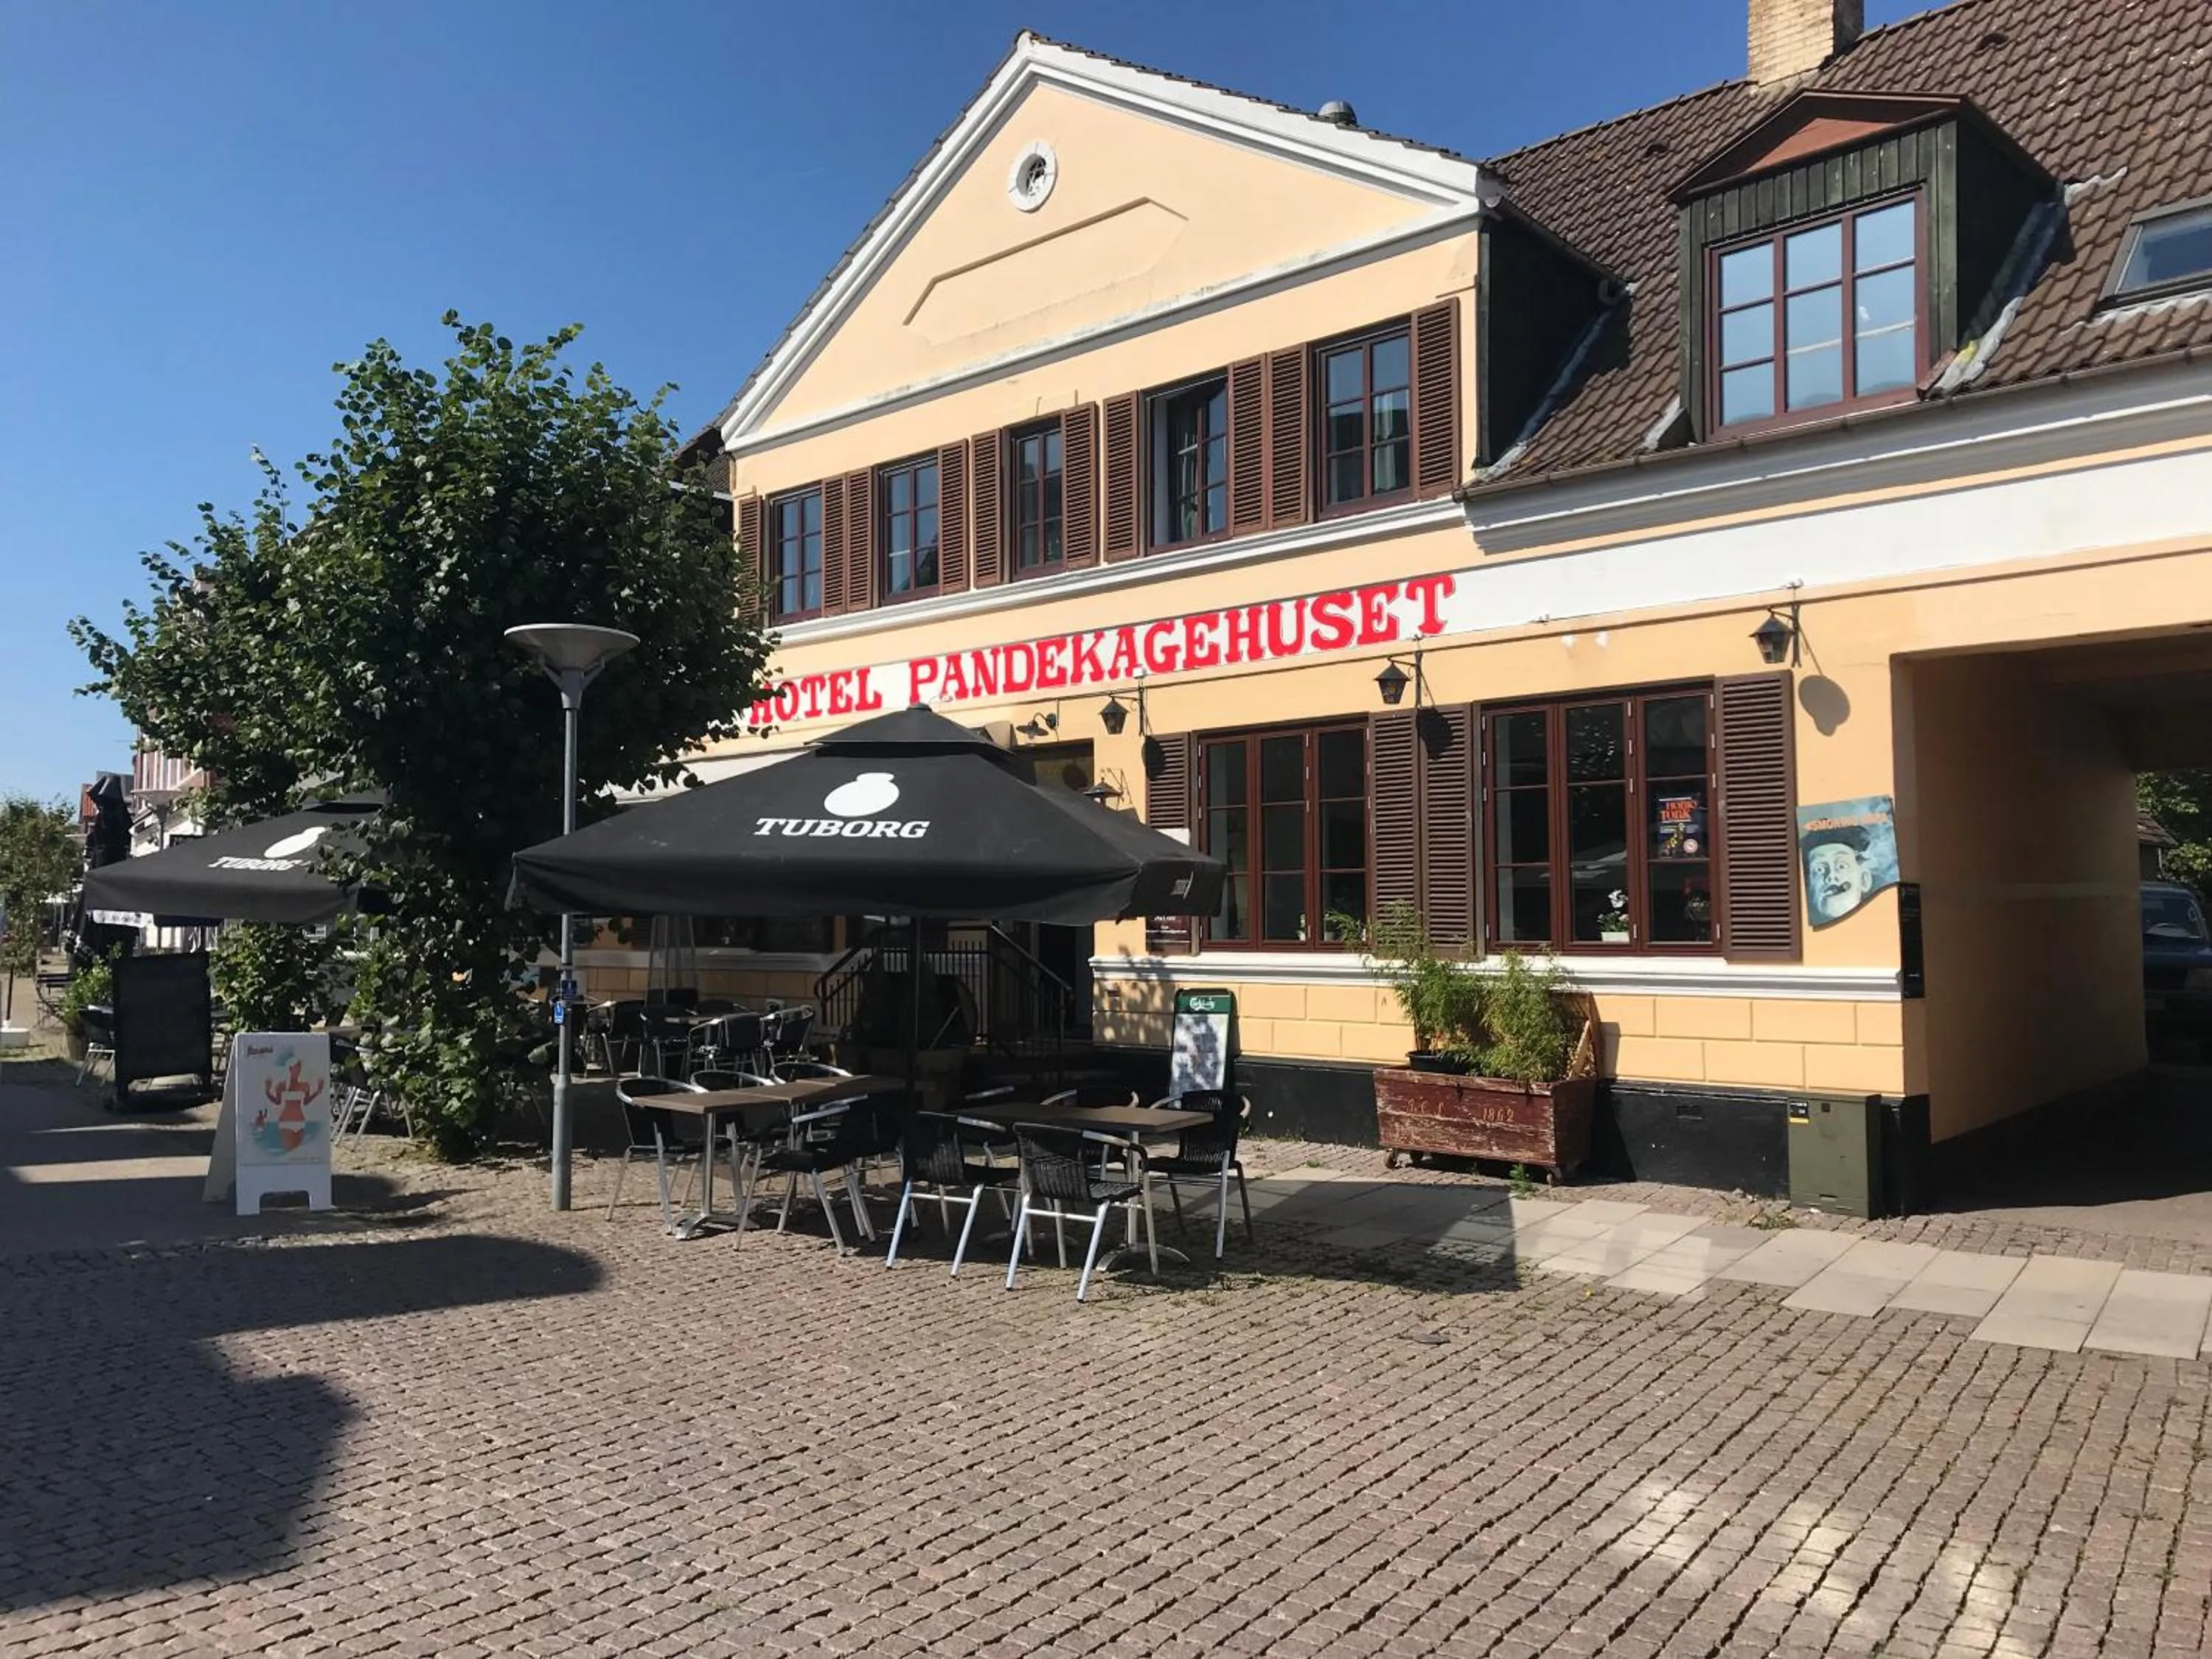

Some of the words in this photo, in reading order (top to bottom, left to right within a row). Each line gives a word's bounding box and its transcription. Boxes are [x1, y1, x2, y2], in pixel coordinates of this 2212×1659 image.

[750, 666, 882, 724] HOTEL
[909, 573, 1454, 705] PANDEKAGEHUSET
[754, 818, 931, 838] TUBORG
